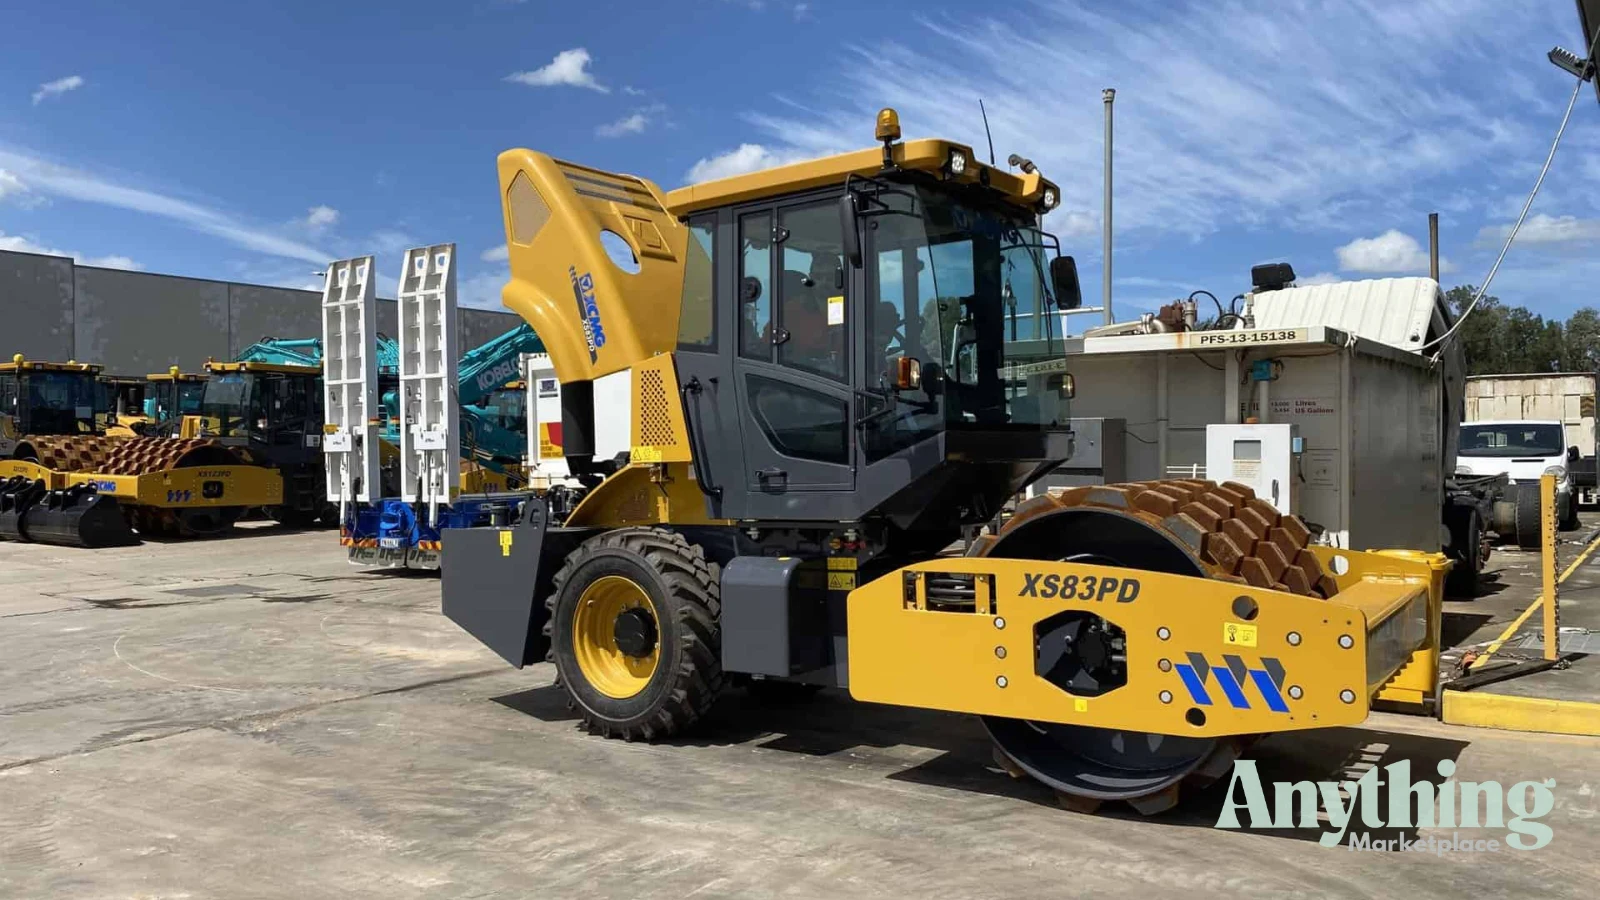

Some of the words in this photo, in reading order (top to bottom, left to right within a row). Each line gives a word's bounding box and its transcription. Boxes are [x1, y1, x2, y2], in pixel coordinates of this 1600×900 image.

[582, 292, 606, 348] XCMG
[1200, 331, 1296, 344] PFS-13-15138
[1018, 573, 1141, 603] XS83PD
